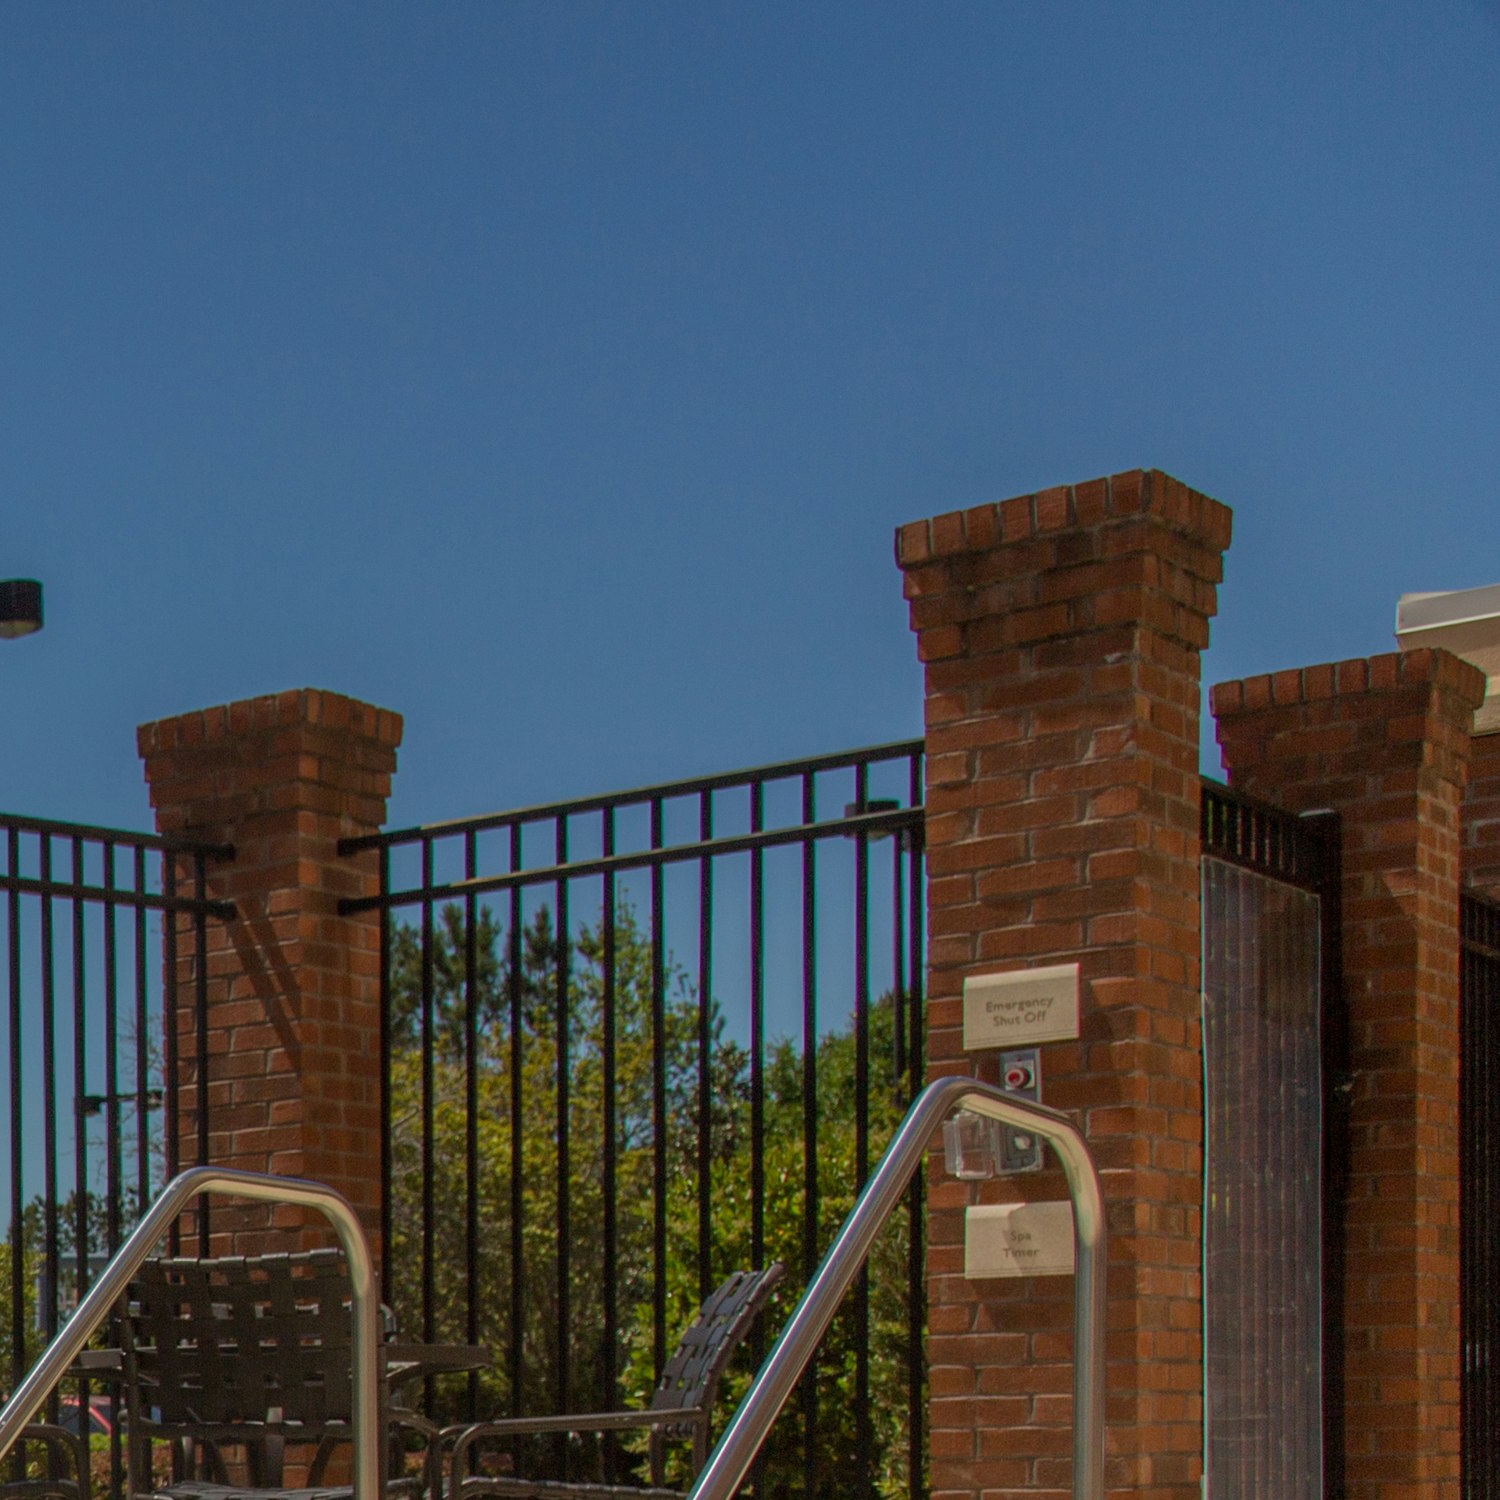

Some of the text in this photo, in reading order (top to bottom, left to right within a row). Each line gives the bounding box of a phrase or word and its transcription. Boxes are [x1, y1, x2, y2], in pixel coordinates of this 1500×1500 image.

[985, 997, 1054, 1013] Emergency
[993, 1010, 1047, 1027] Shut Off
[1010, 1230, 1032, 1242] Spa
[1002, 1247, 1040, 1258] Timer
